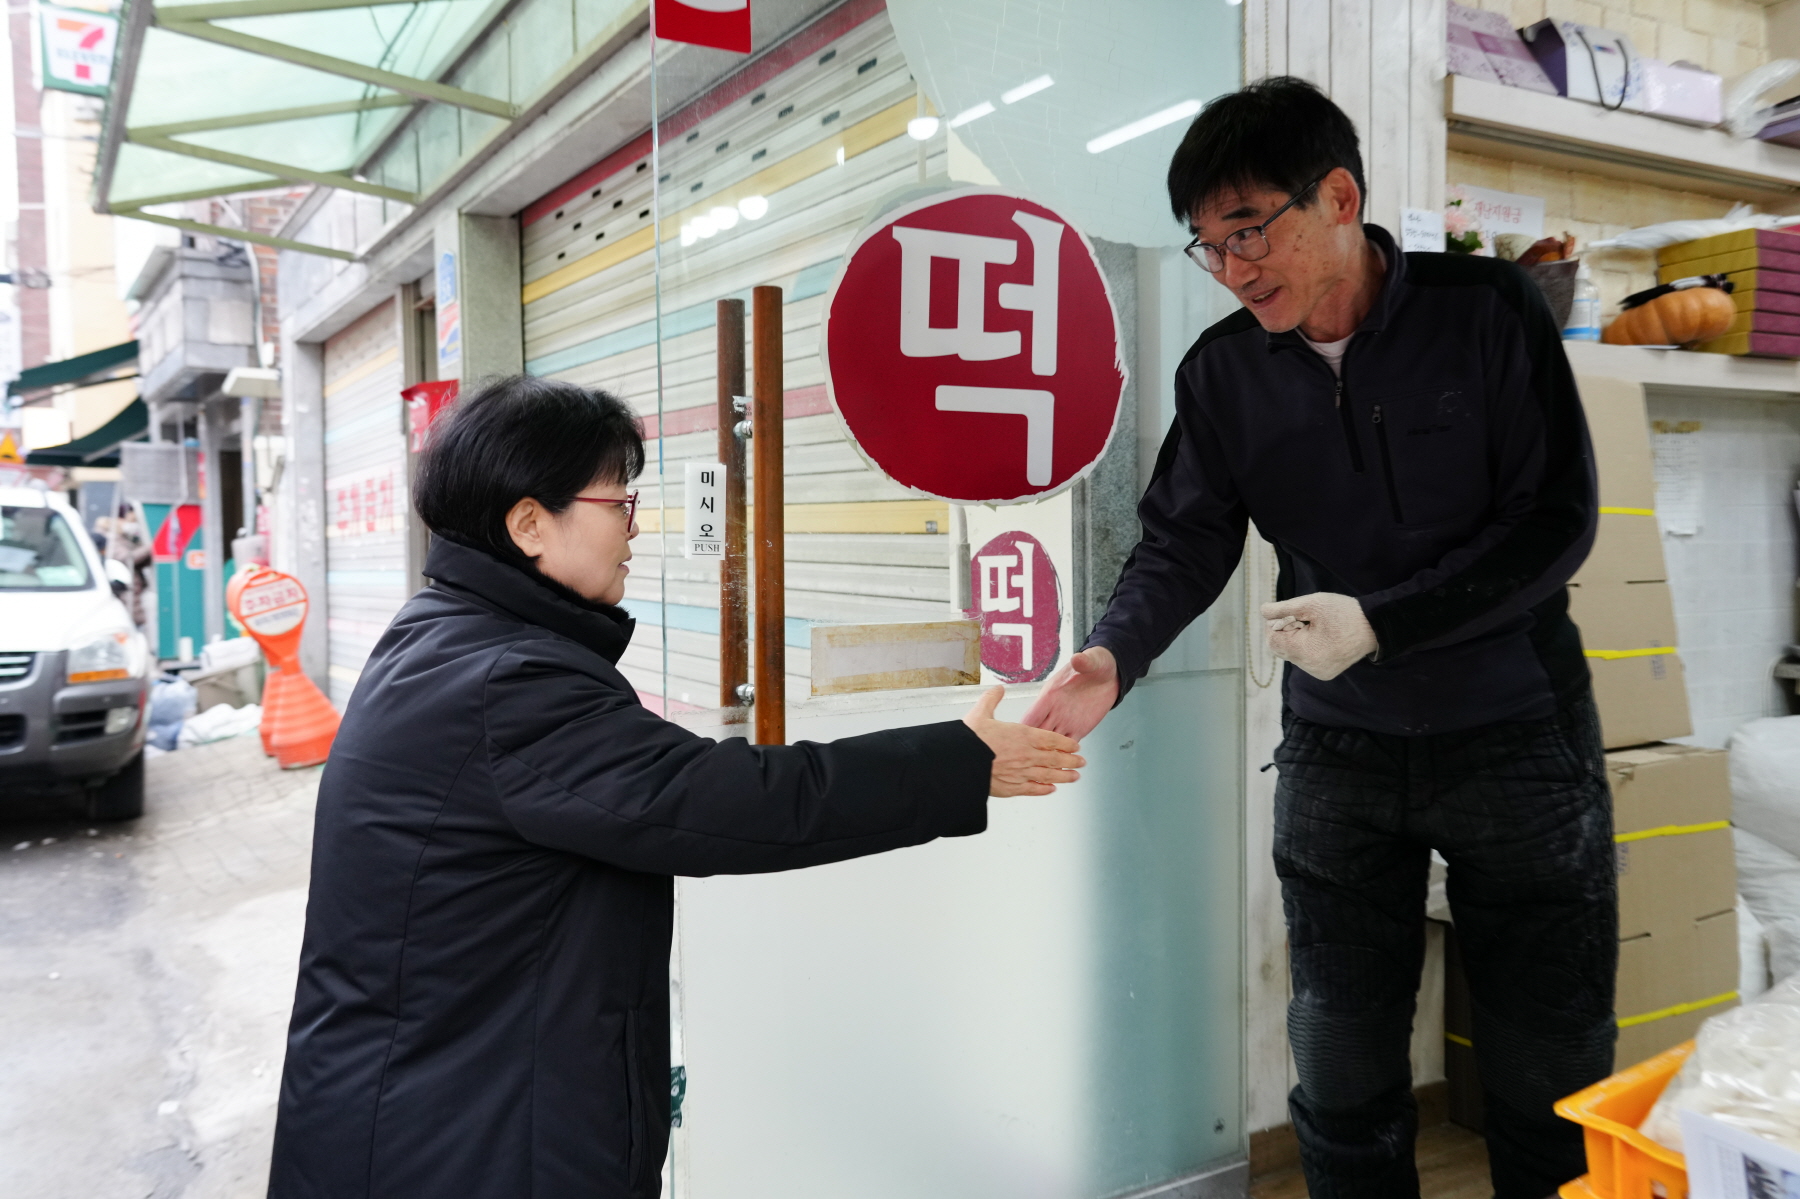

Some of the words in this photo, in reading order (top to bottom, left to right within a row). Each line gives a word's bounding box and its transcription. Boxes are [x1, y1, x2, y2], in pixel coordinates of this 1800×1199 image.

[1475, 201, 1521, 224] 재난지원금
[892, 210, 1065, 487] 떡
[699, 471, 715, 538] 미시오
[694, 543, 720, 553] PUSH
[977, 540, 1034, 671] 떡
